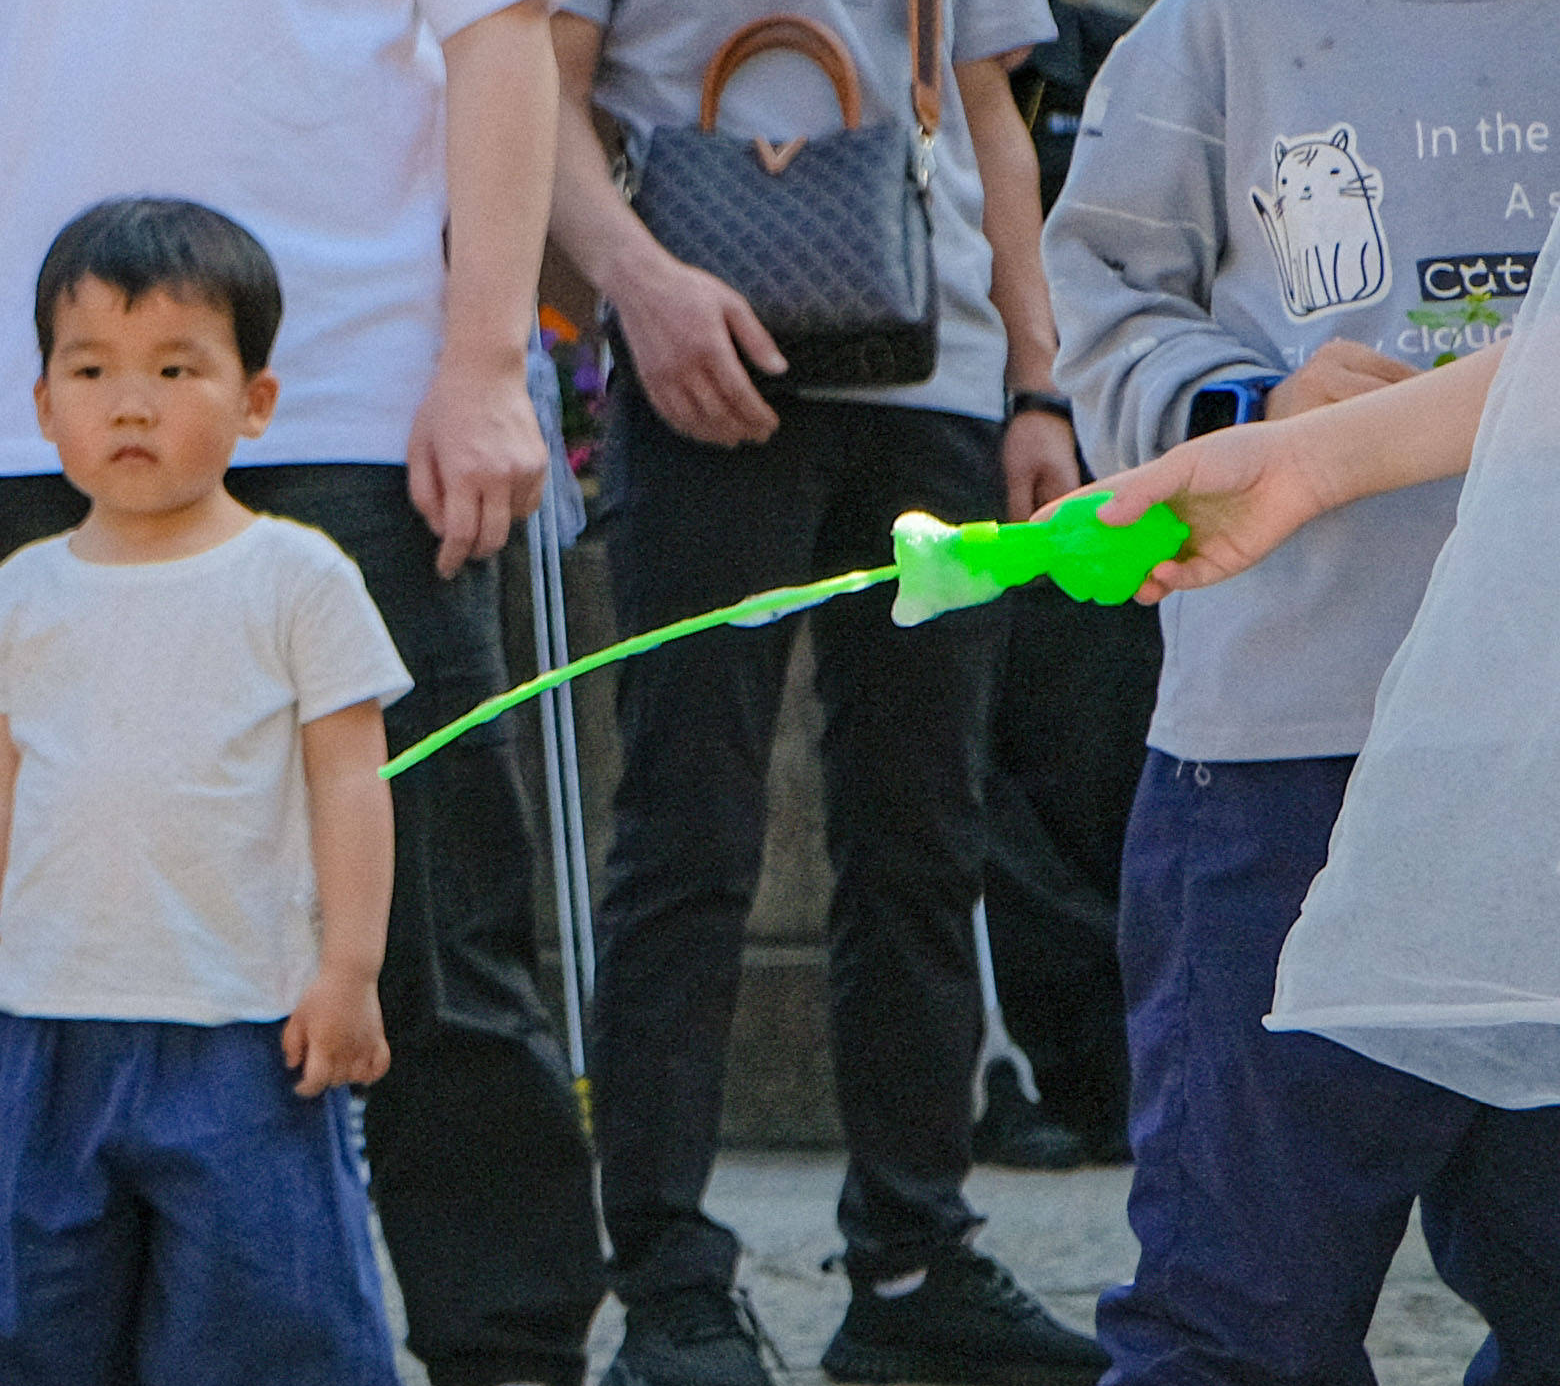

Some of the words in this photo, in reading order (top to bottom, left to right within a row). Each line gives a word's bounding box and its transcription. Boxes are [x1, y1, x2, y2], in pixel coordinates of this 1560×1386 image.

[1416, 119, 1458, 159] In
[1476, 111, 1549, 154] the
[1505, 181, 1535, 219] A
